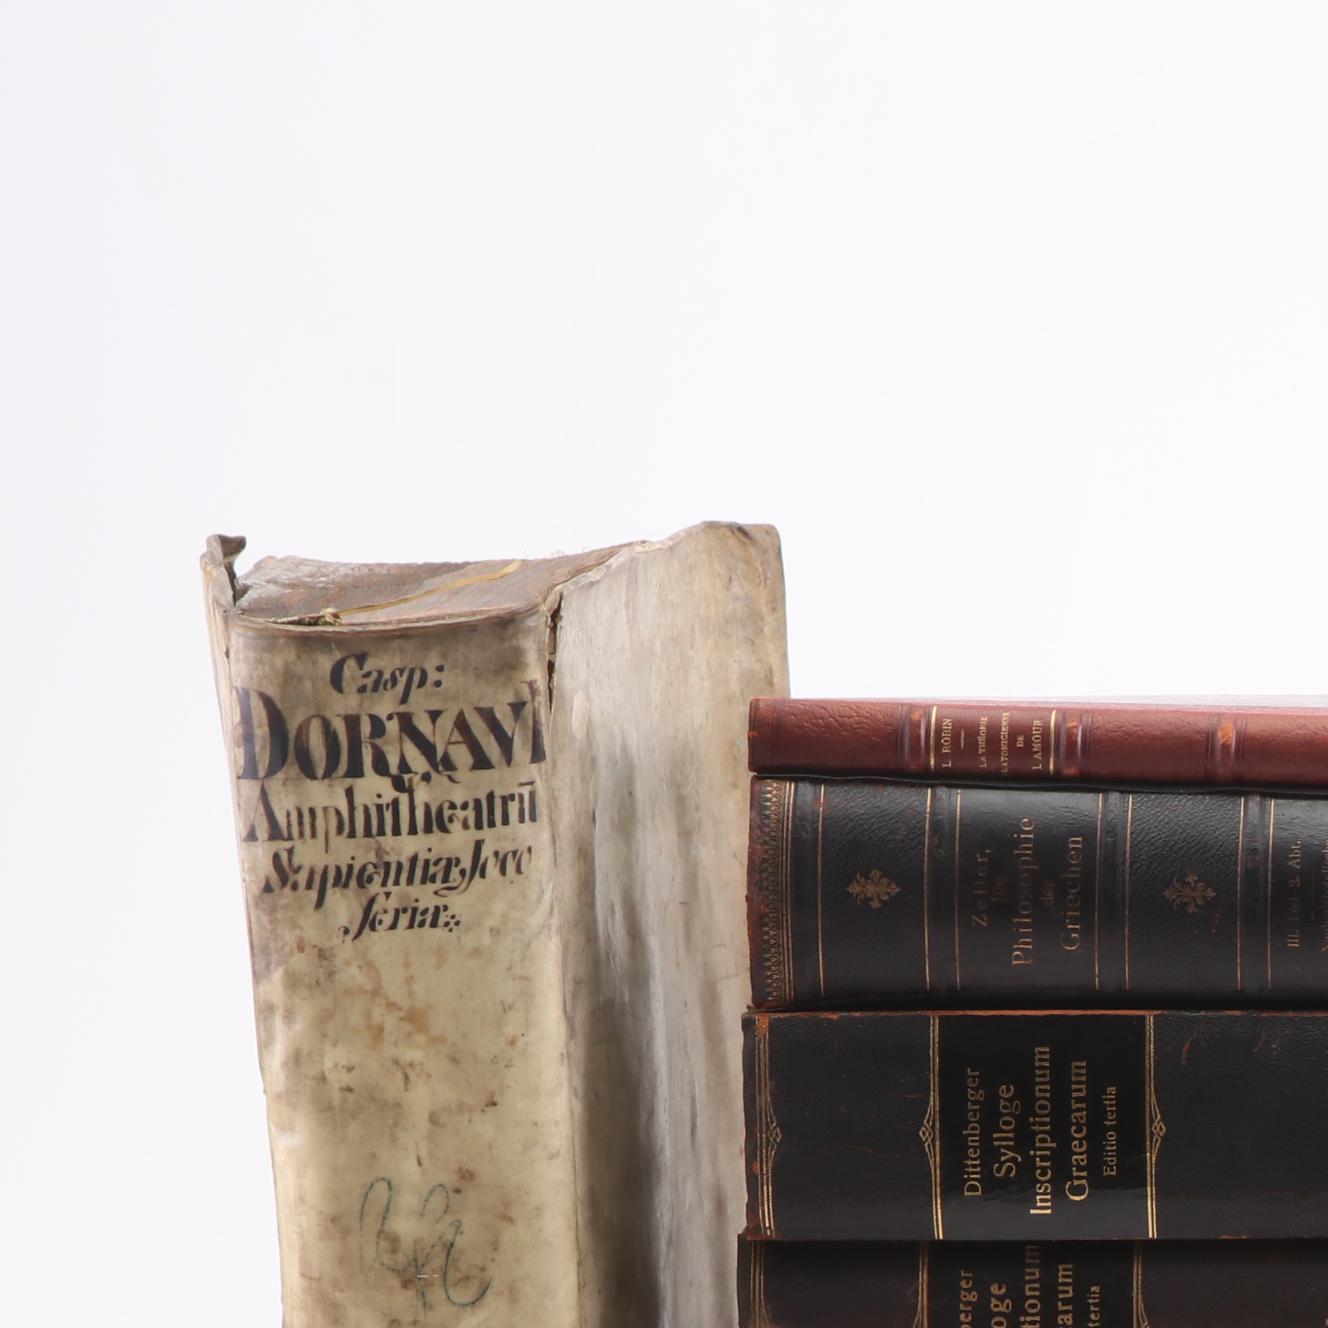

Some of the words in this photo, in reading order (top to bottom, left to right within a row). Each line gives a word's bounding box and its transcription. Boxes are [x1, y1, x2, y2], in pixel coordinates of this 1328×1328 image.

[941, 718, 953, 753] ROBIN
[1009, 816, 1040, 966] Philosophie
[1060, 835, 1083, 952] Griechen
[962, 1067, 985, 1197] Dittenberger
[992, 1084, 1021, 1178] Sylloge
[1028, 1045, 1057, 1215] Inscriptionum
[1064, 1060, 1089, 1201] Graecarum
[1101, 1086, 1118, 1127] tertia
[1101, 1131, 1118, 1177] Editio
[1086, 1284, 1101, 1328] tertia
